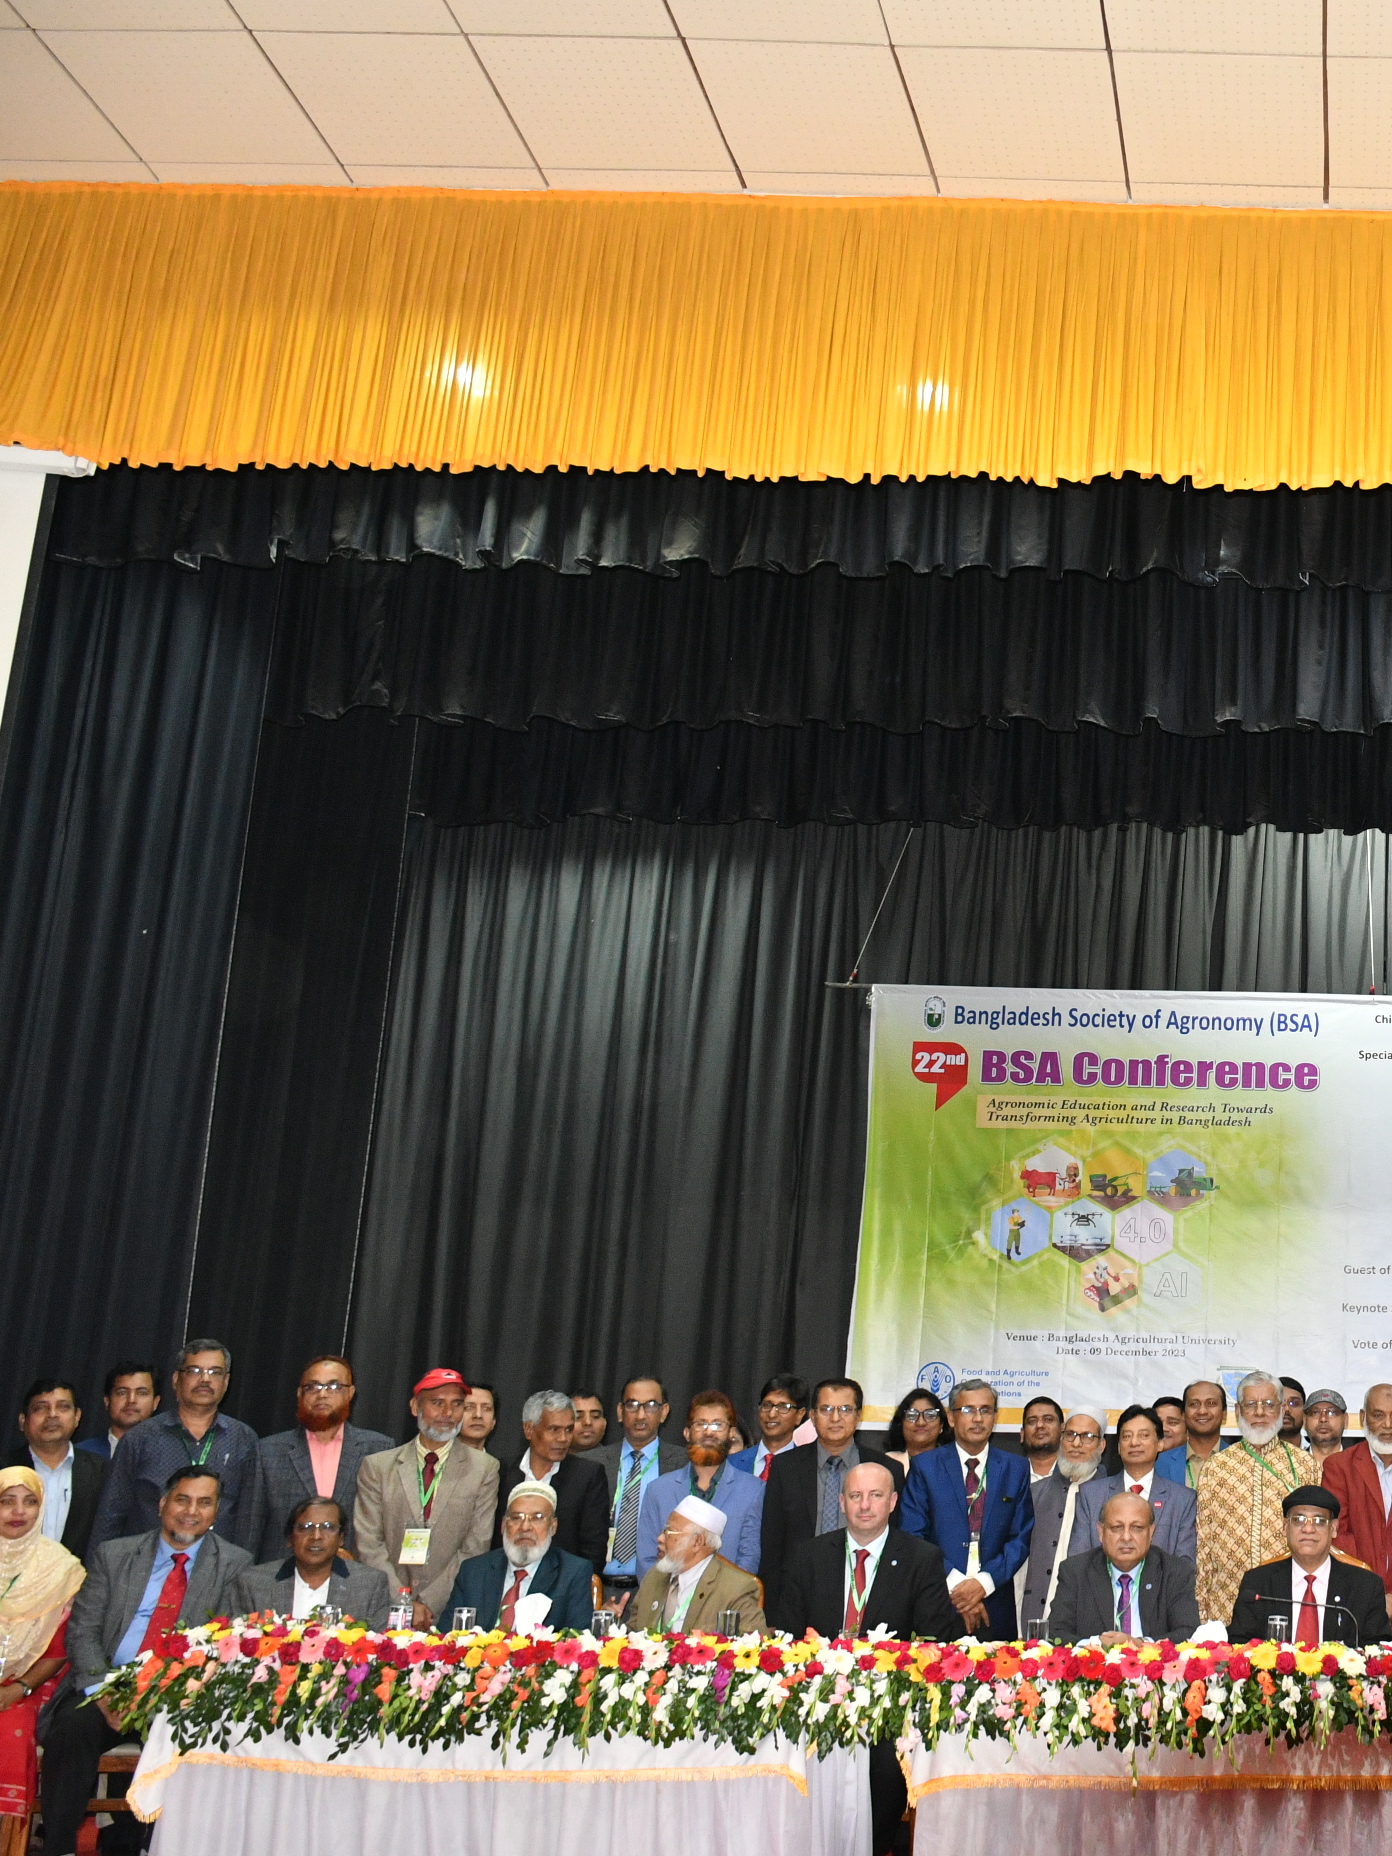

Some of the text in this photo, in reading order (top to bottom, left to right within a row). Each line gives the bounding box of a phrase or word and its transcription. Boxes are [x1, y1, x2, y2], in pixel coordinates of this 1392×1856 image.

[954, 1005, 1061, 1030] Bangladesh
[1068, 1008, 1136, 1033] Society
[1142, 1009, 1161, 1029] of
[1166, 1011, 1263, 1036] Agronomy
[1270, 1012, 1319, 1037] (BSA)
[914, 1051, 966, 1073] 22nd
[980, 1050, 1320, 1092] BSA Conference
[986, 1098, 1273, 1114] Agronomic Education and Research Towards
[986, 1111, 1251, 1128] Transforming Agriculture in Bangladesh
[1120, 1217, 1166, 1243] 4.0
[1343, 1264, 1377, 1275] Guest
[1379, 1264, 1392, 1275] of
[1153, 1271, 1188, 1297] AI
[1342, 1303, 1387, 1314] Keynote
[1006, 1332, 1238, 1347] Venue Bangladesh Agricultural University
[1352, 1340, 1378, 1349] Vote
[1382, 1339, 1392, 1349] of
[1056, 1346, 1187, 1358] Date 09 December 2023
[961, 1368, 983, 1376] Food
[1002, 1369, 1050, 1378] Agriculture
